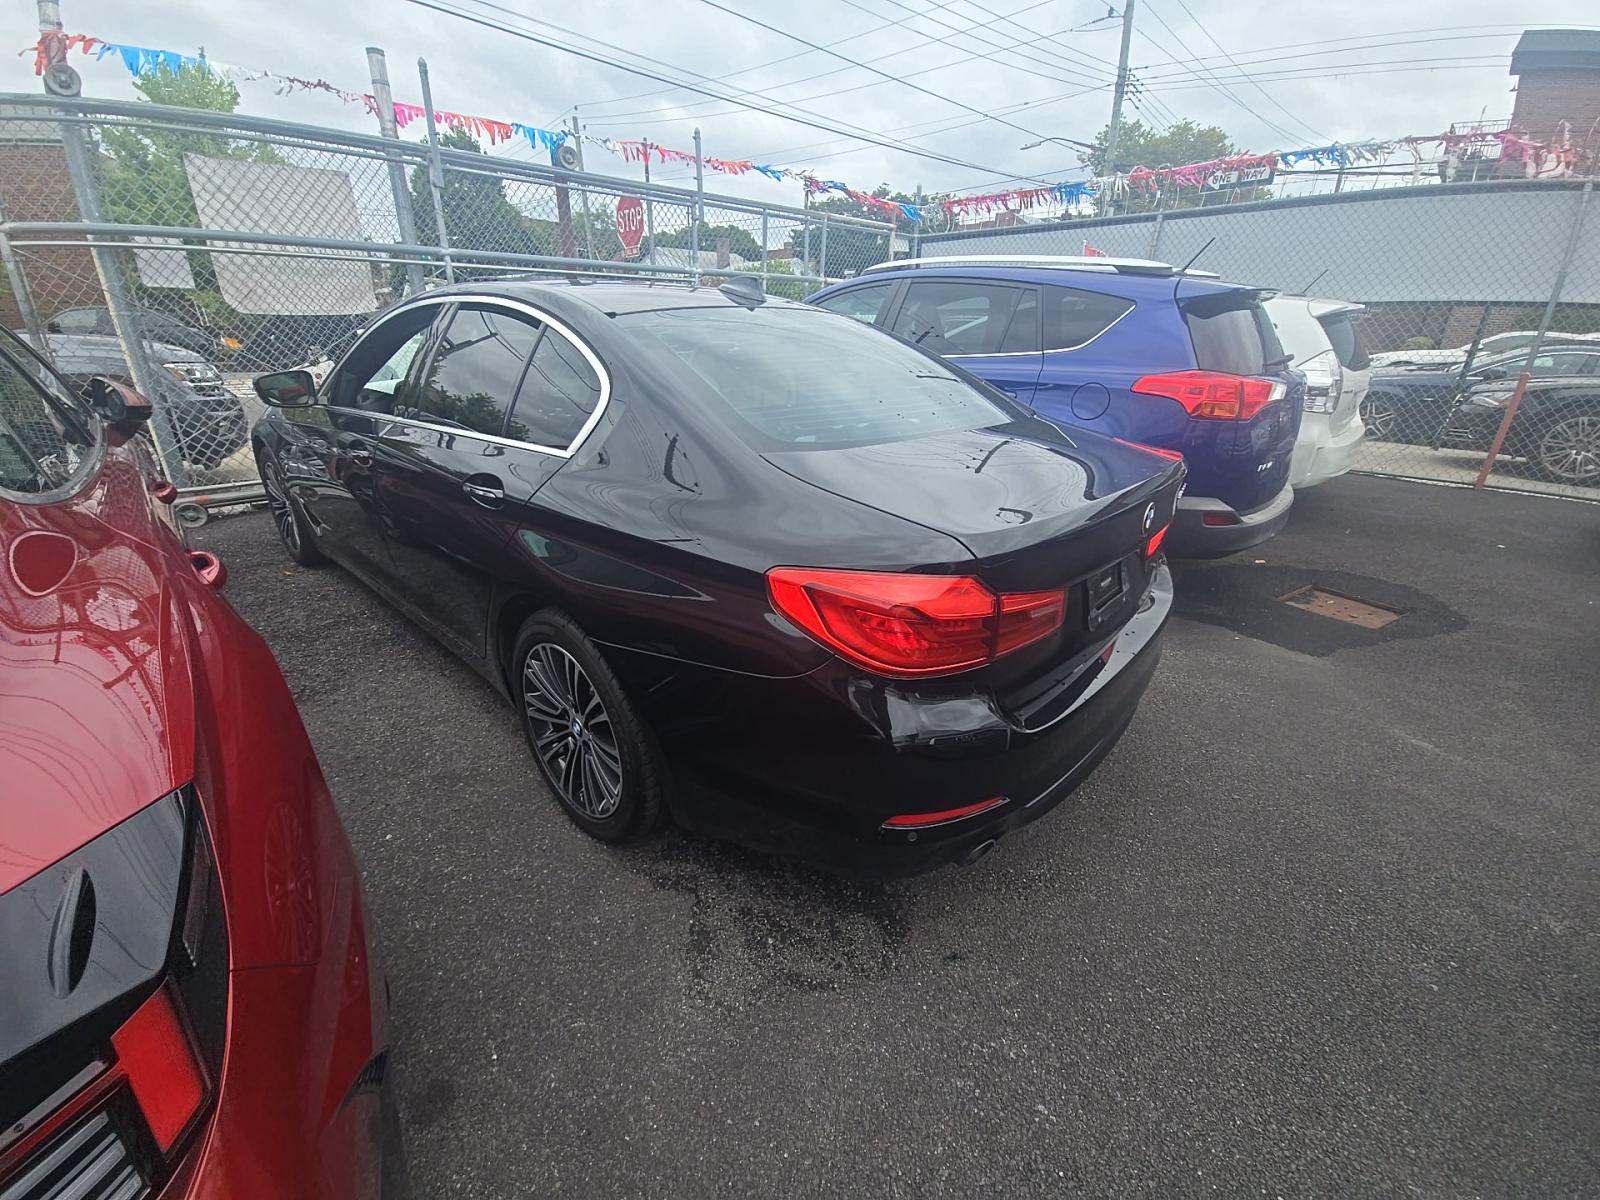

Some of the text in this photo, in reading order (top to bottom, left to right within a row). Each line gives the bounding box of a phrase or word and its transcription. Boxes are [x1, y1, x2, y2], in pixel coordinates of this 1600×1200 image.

[1212, 168, 1266, 185] ONE WAY
[617, 206, 642, 233] STOP
